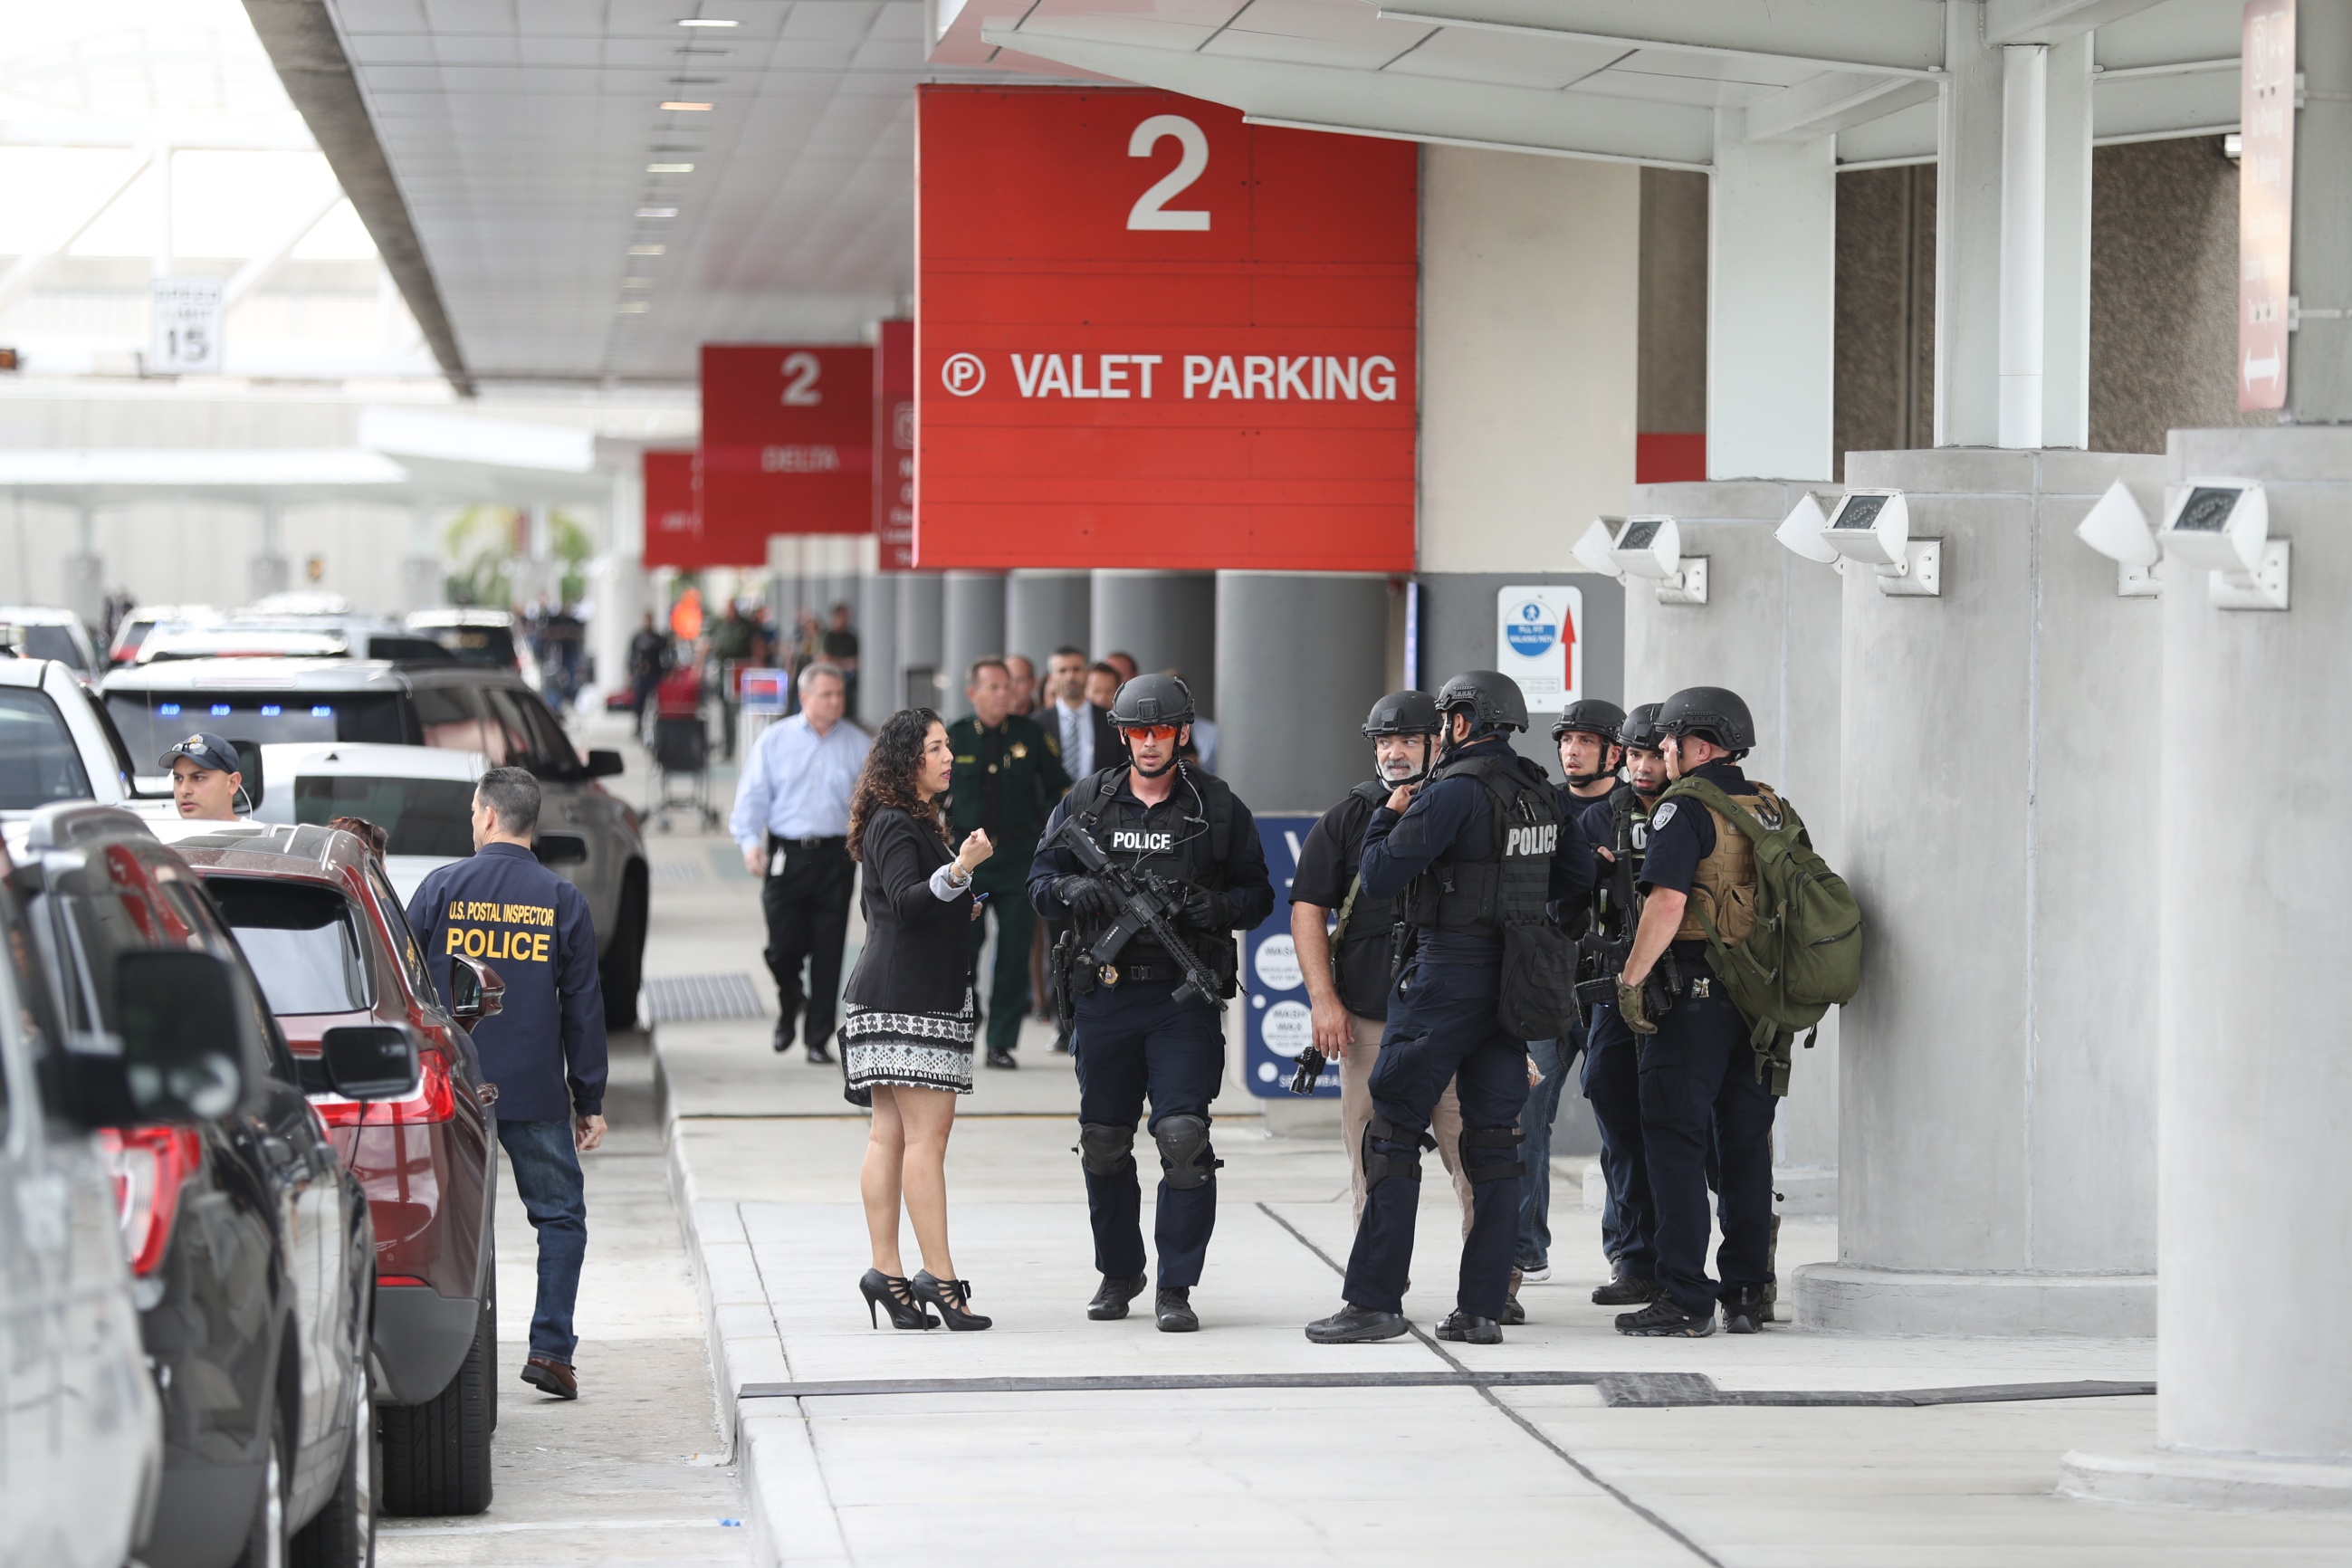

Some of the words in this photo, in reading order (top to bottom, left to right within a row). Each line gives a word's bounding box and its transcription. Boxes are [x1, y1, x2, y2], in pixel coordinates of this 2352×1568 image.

[1127, 114, 1210, 231] 2
[166, 327, 210, 364] 15
[780, 351, 822, 406] 2
[1009, 353, 1163, 398] VALET
[1182, 354, 1397, 402] PARKING
[1113, 831, 1171, 850] POLICE
[449, 901, 465, 921] U.S.
[467, 902, 502, 923] POSTAL
[502, 904, 555, 927] INSPECTOR
[445, 927, 550, 962] POLICE
